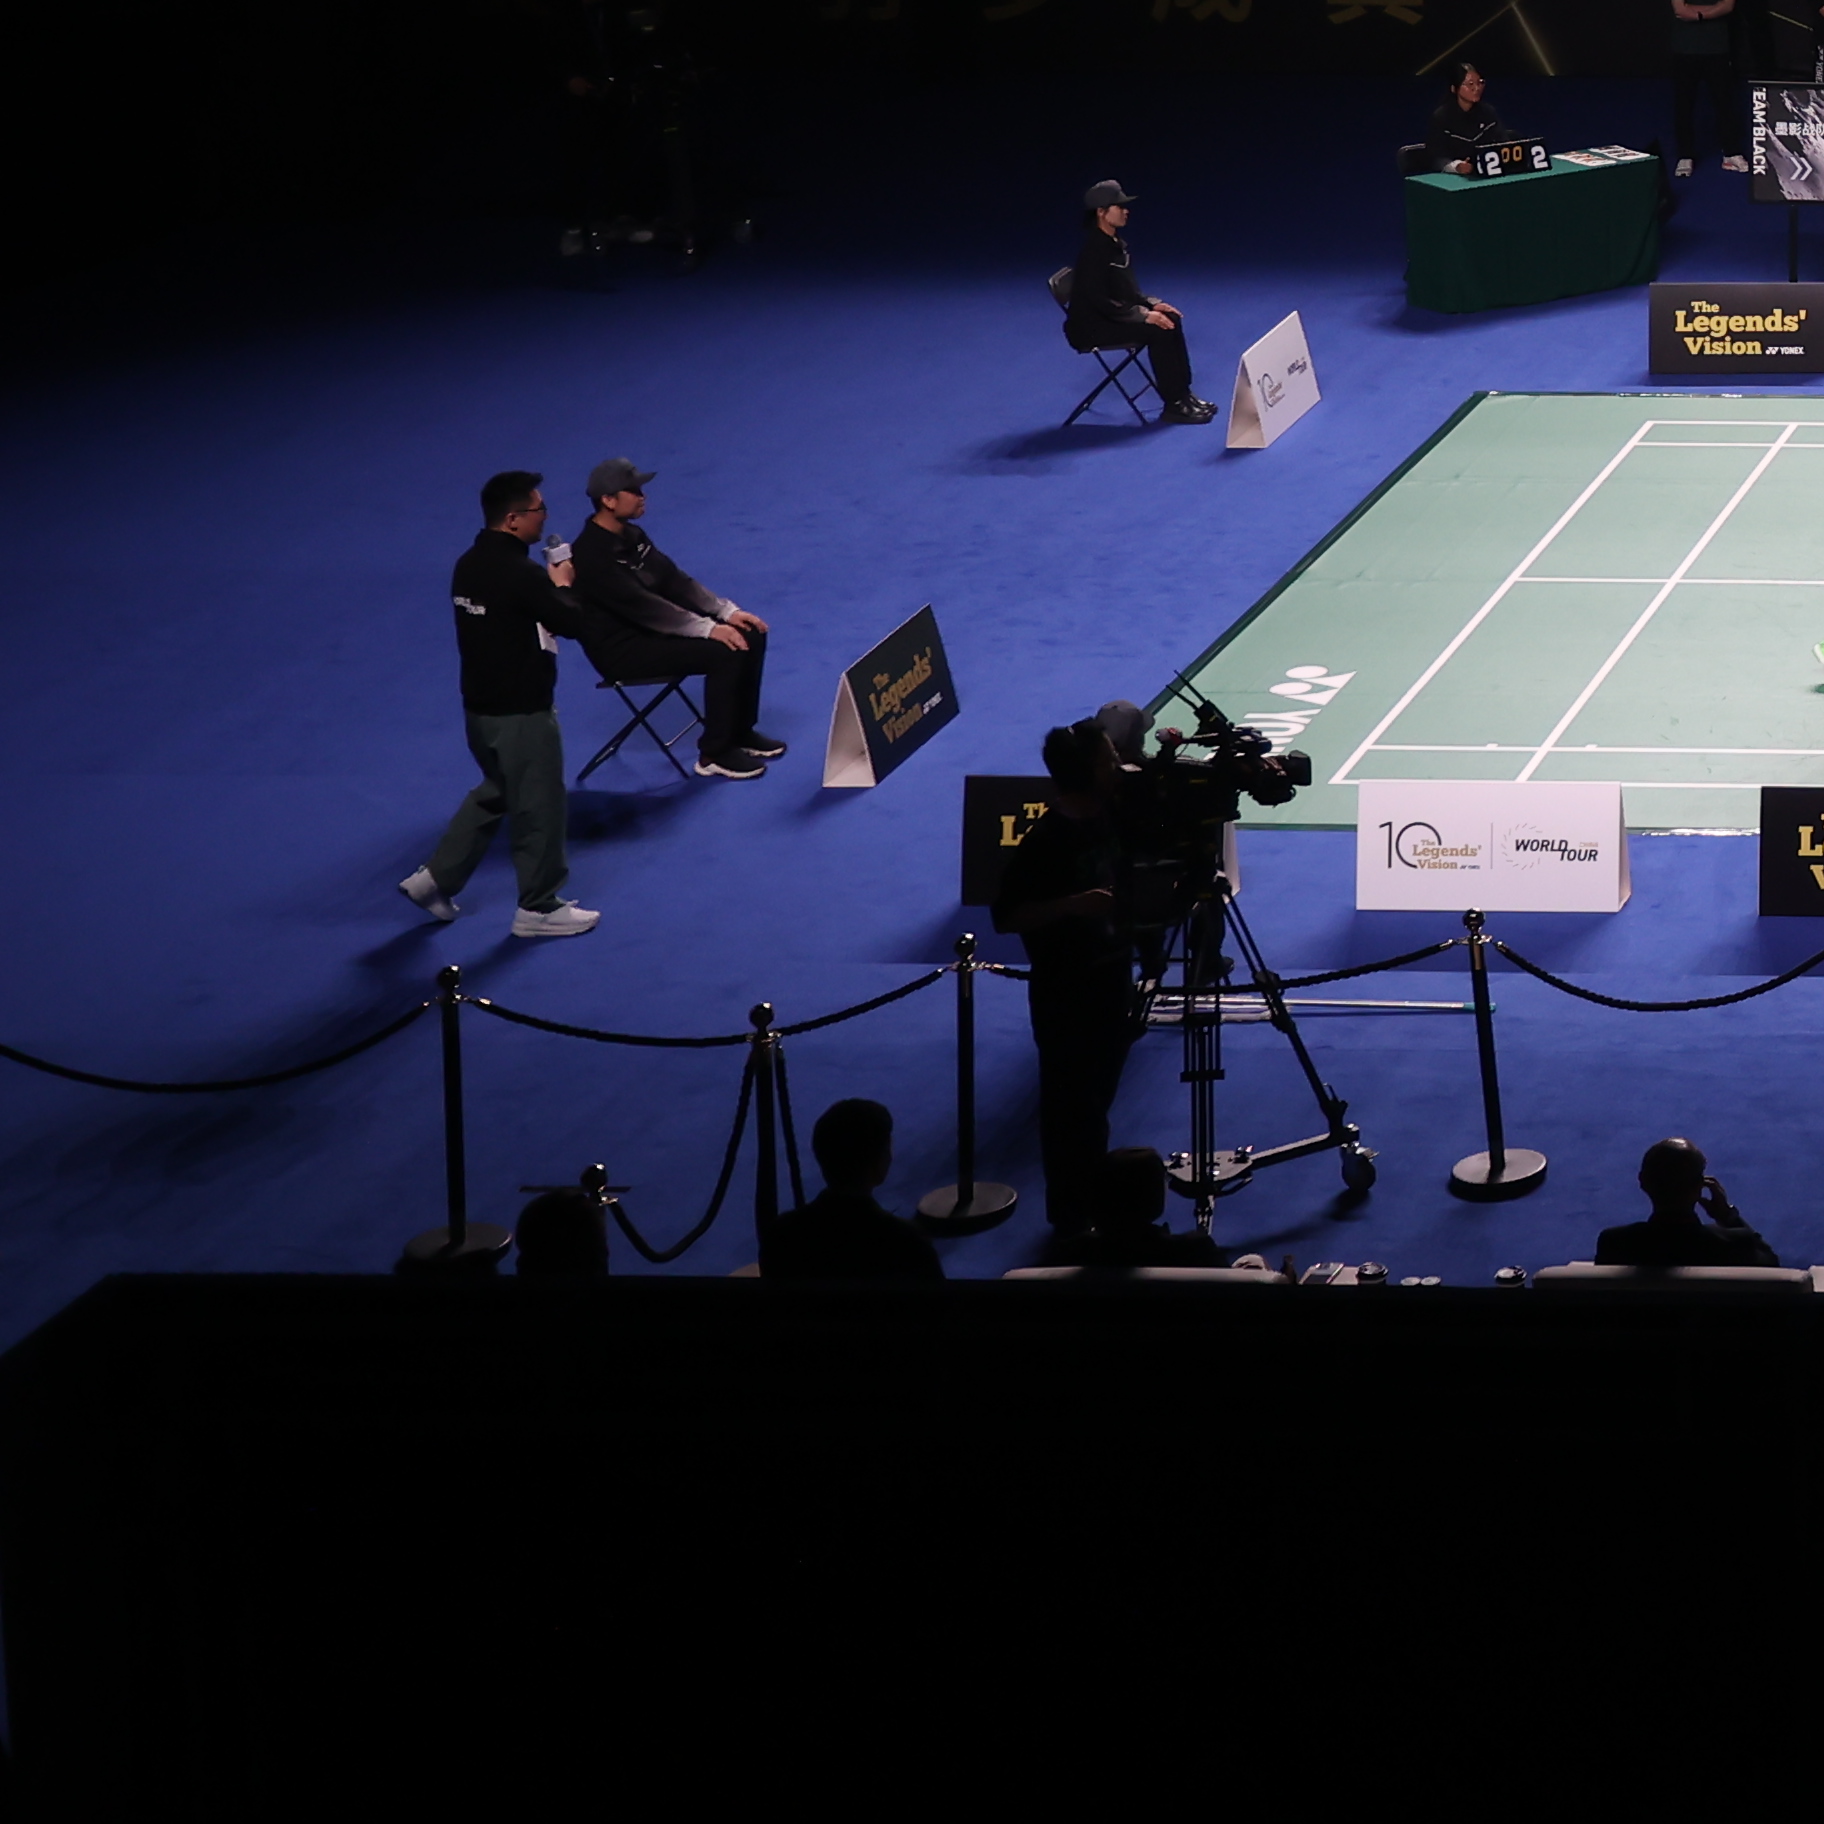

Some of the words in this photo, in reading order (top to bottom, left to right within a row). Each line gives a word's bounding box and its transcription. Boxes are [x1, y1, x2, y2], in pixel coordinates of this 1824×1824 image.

[1531, 144, 1549, 170] 2
[1752, 127, 1767, 175] BLACK
[1691, 300, 1720, 313] The
[1675, 308, 1807, 337] Legends'
[1683, 336, 1763, 355] Vision
[1780, 346, 1805, 355] YONEX
[1515, 839, 1569, 852] WORLD
[1560, 849, 1598, 862] TOUR
